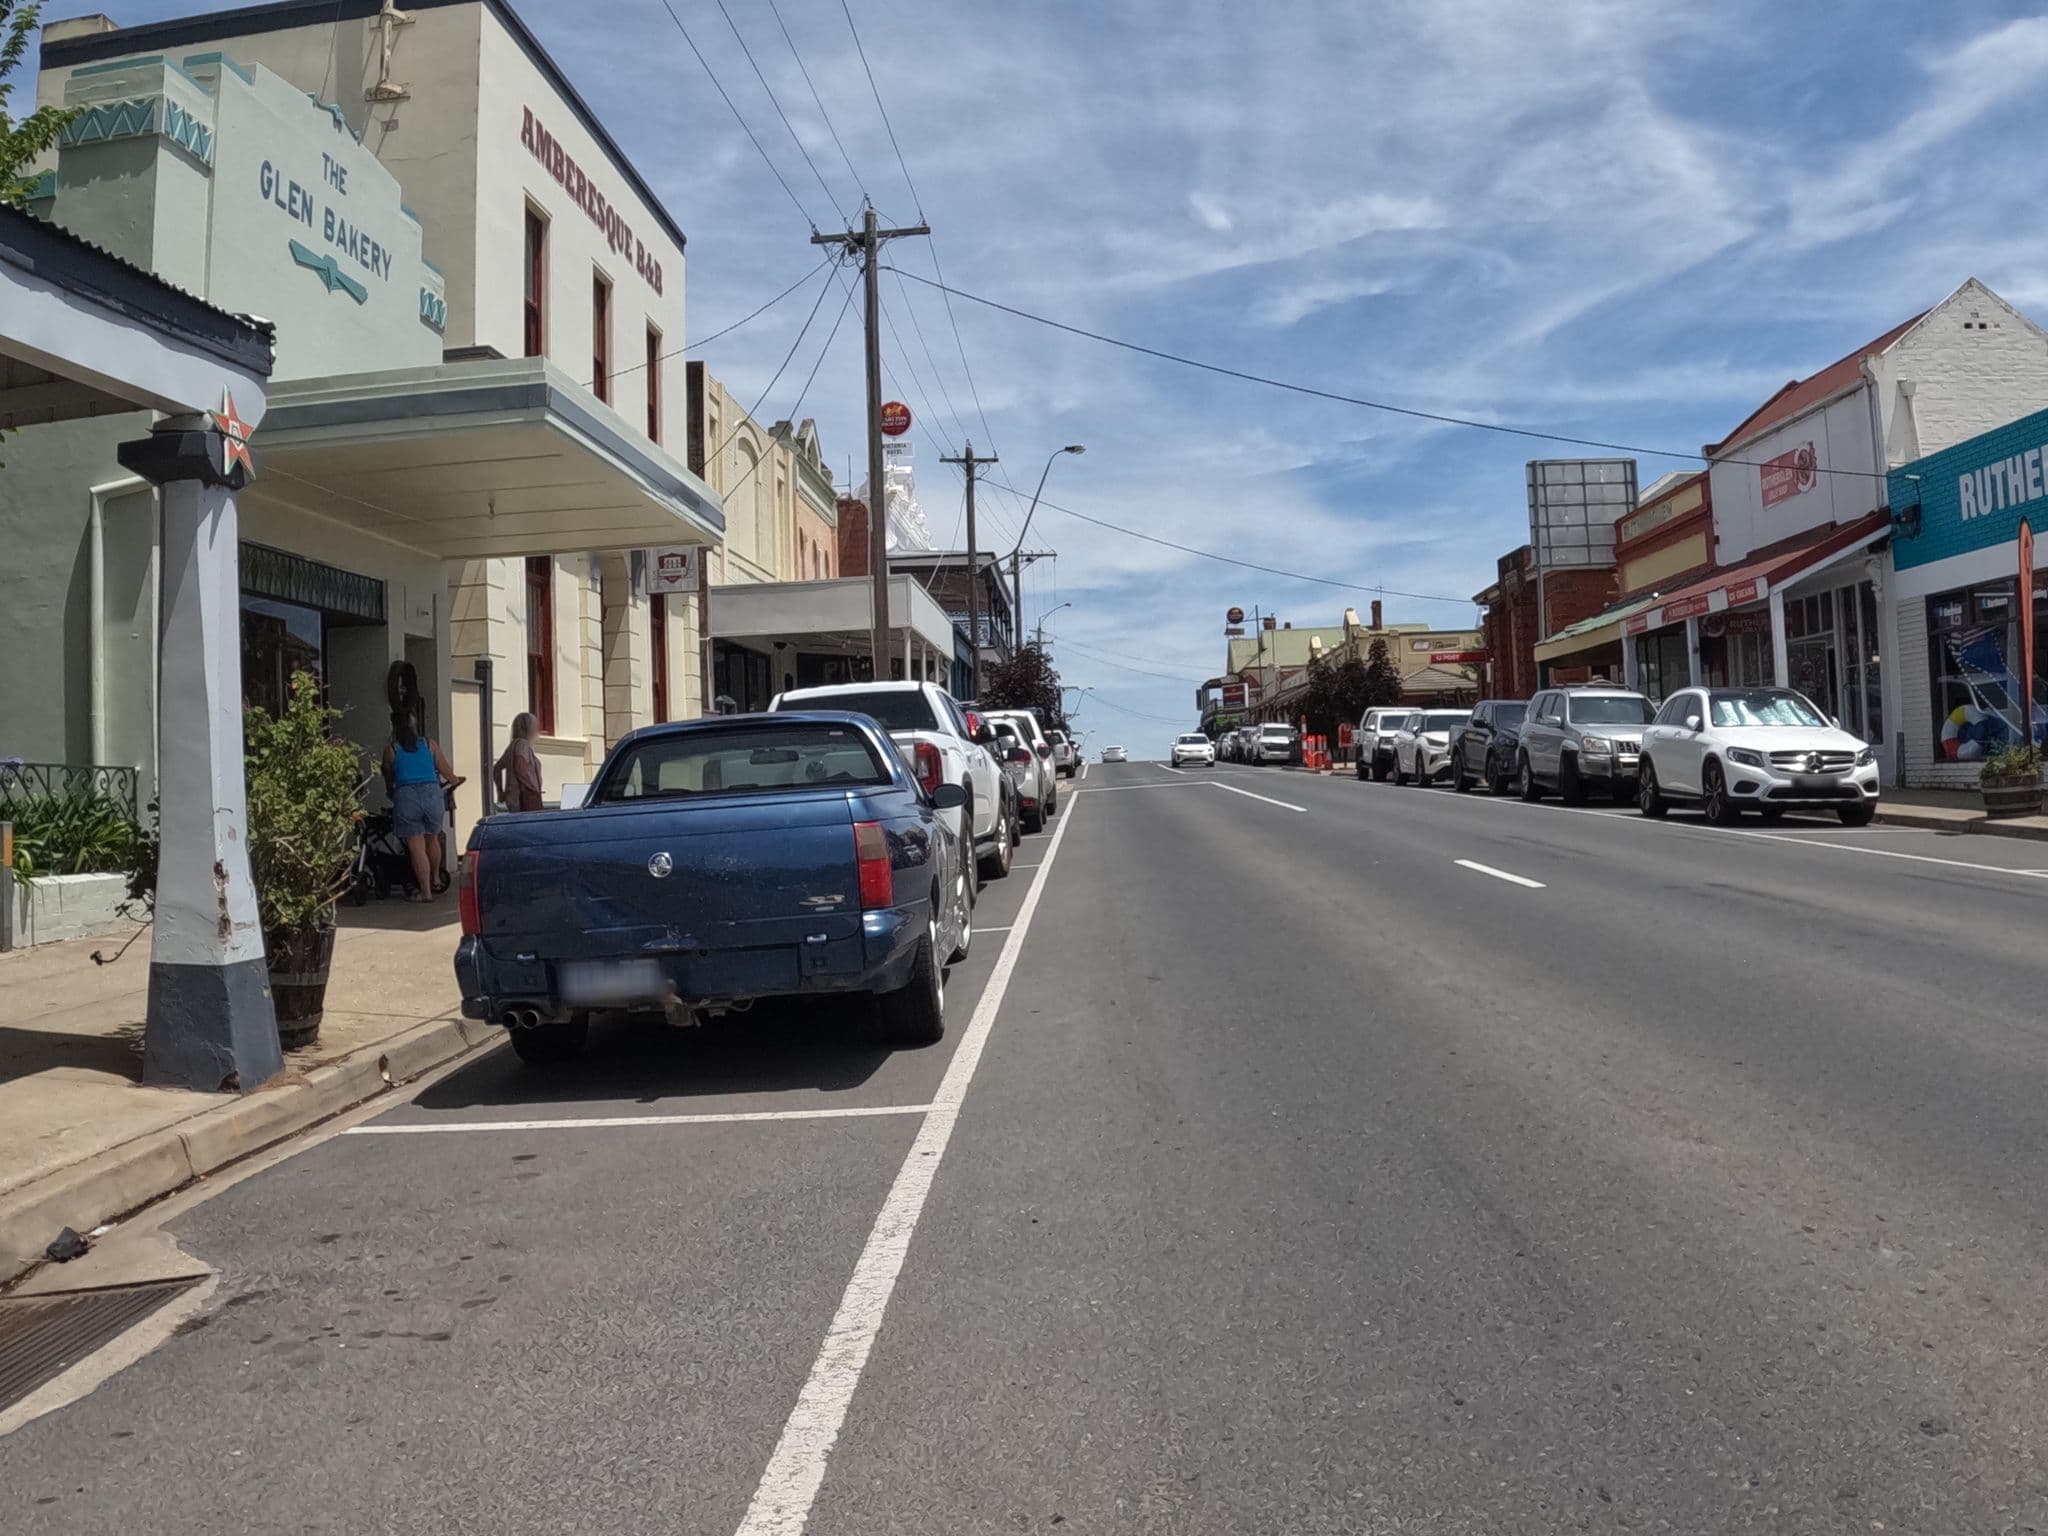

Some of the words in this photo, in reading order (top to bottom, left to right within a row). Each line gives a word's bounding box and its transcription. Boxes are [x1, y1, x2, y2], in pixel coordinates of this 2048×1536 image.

[260, 160, 313, 228] GLEN
[324, 206, 392, 282] BAKERY
[322, 151, 348, 196] THE
[521, 104, 633, 267] AMBERESQUE
[636, 237, 663, 298] B&B
